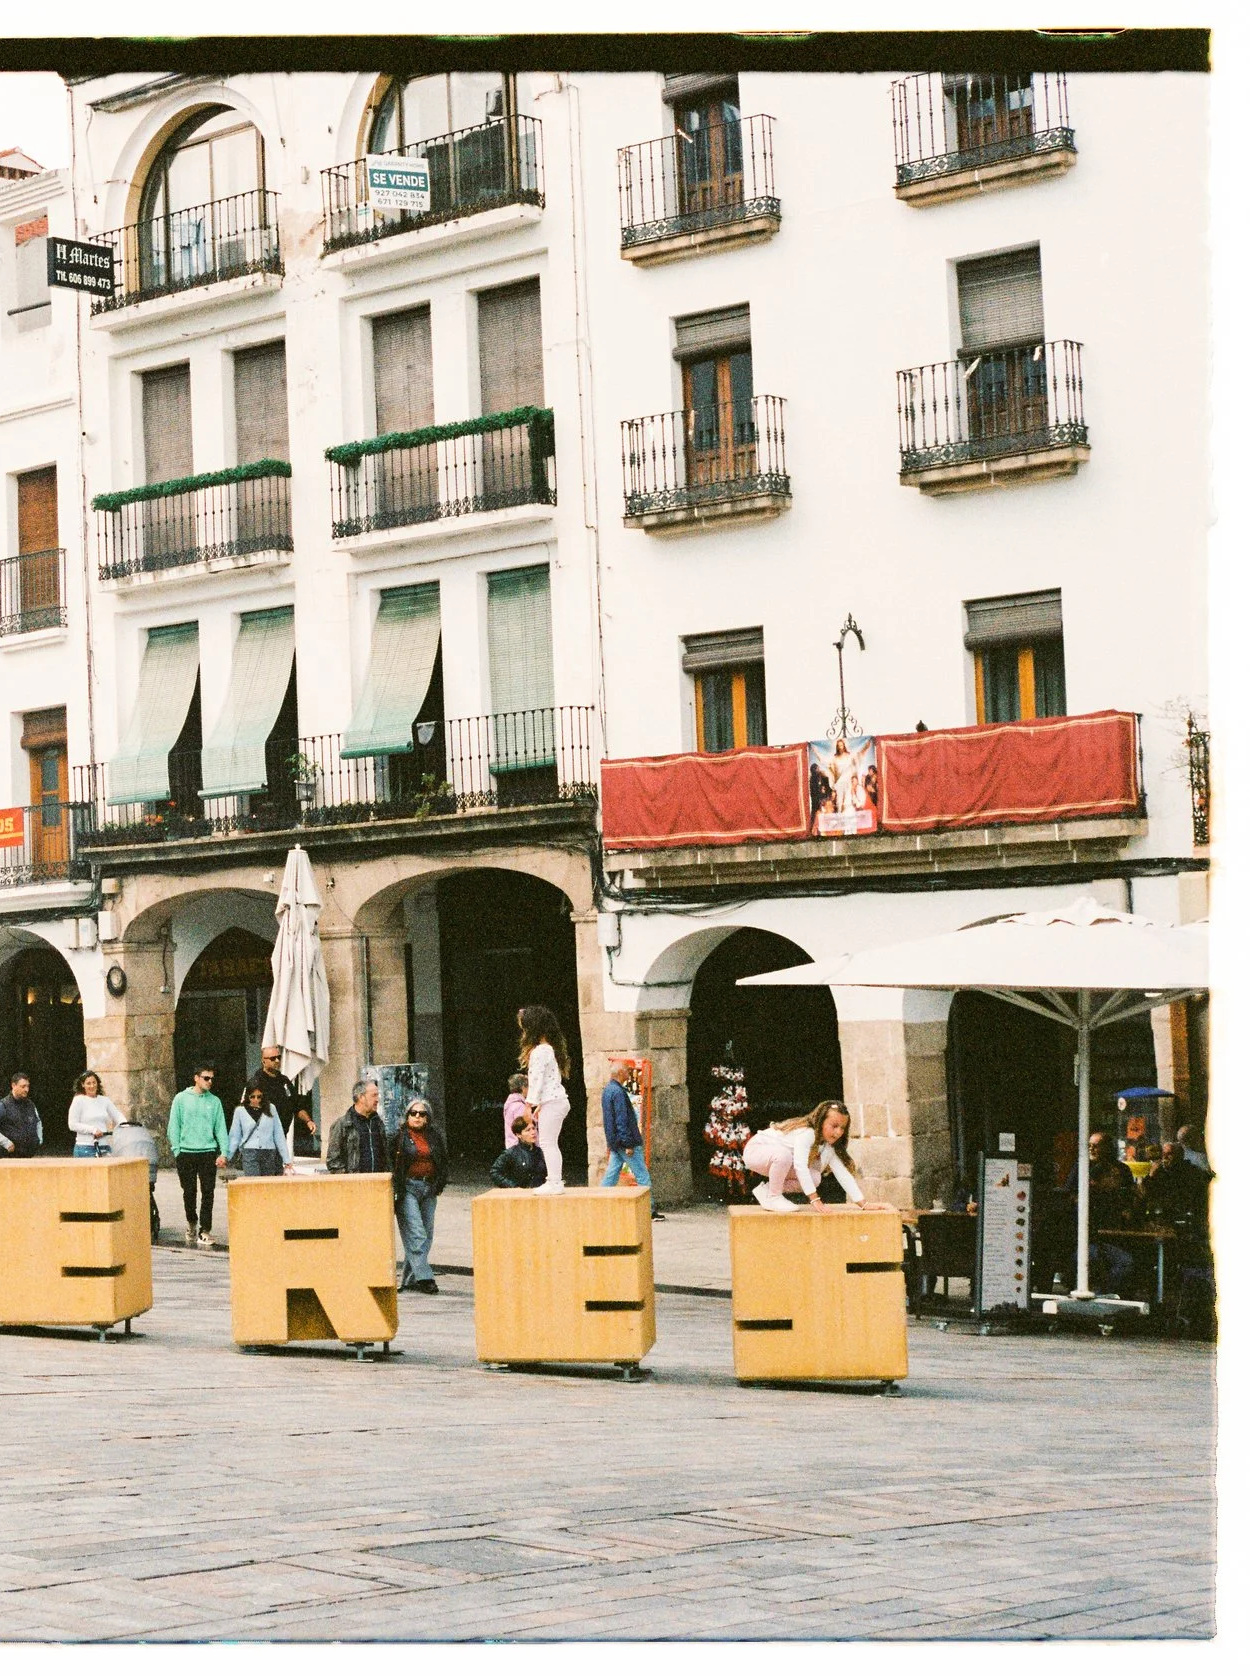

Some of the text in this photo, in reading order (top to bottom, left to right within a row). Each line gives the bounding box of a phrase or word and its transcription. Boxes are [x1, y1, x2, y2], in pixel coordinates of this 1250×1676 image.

[373, 173, 425, 187] SE VENDE
[375, 189, 390, 197] 927
[69, 247, 110, 268] Martes
[69, 272, 82, 284] 606
[83, 275, 96, 287] 899
[97, 278, 110, 289] 473
